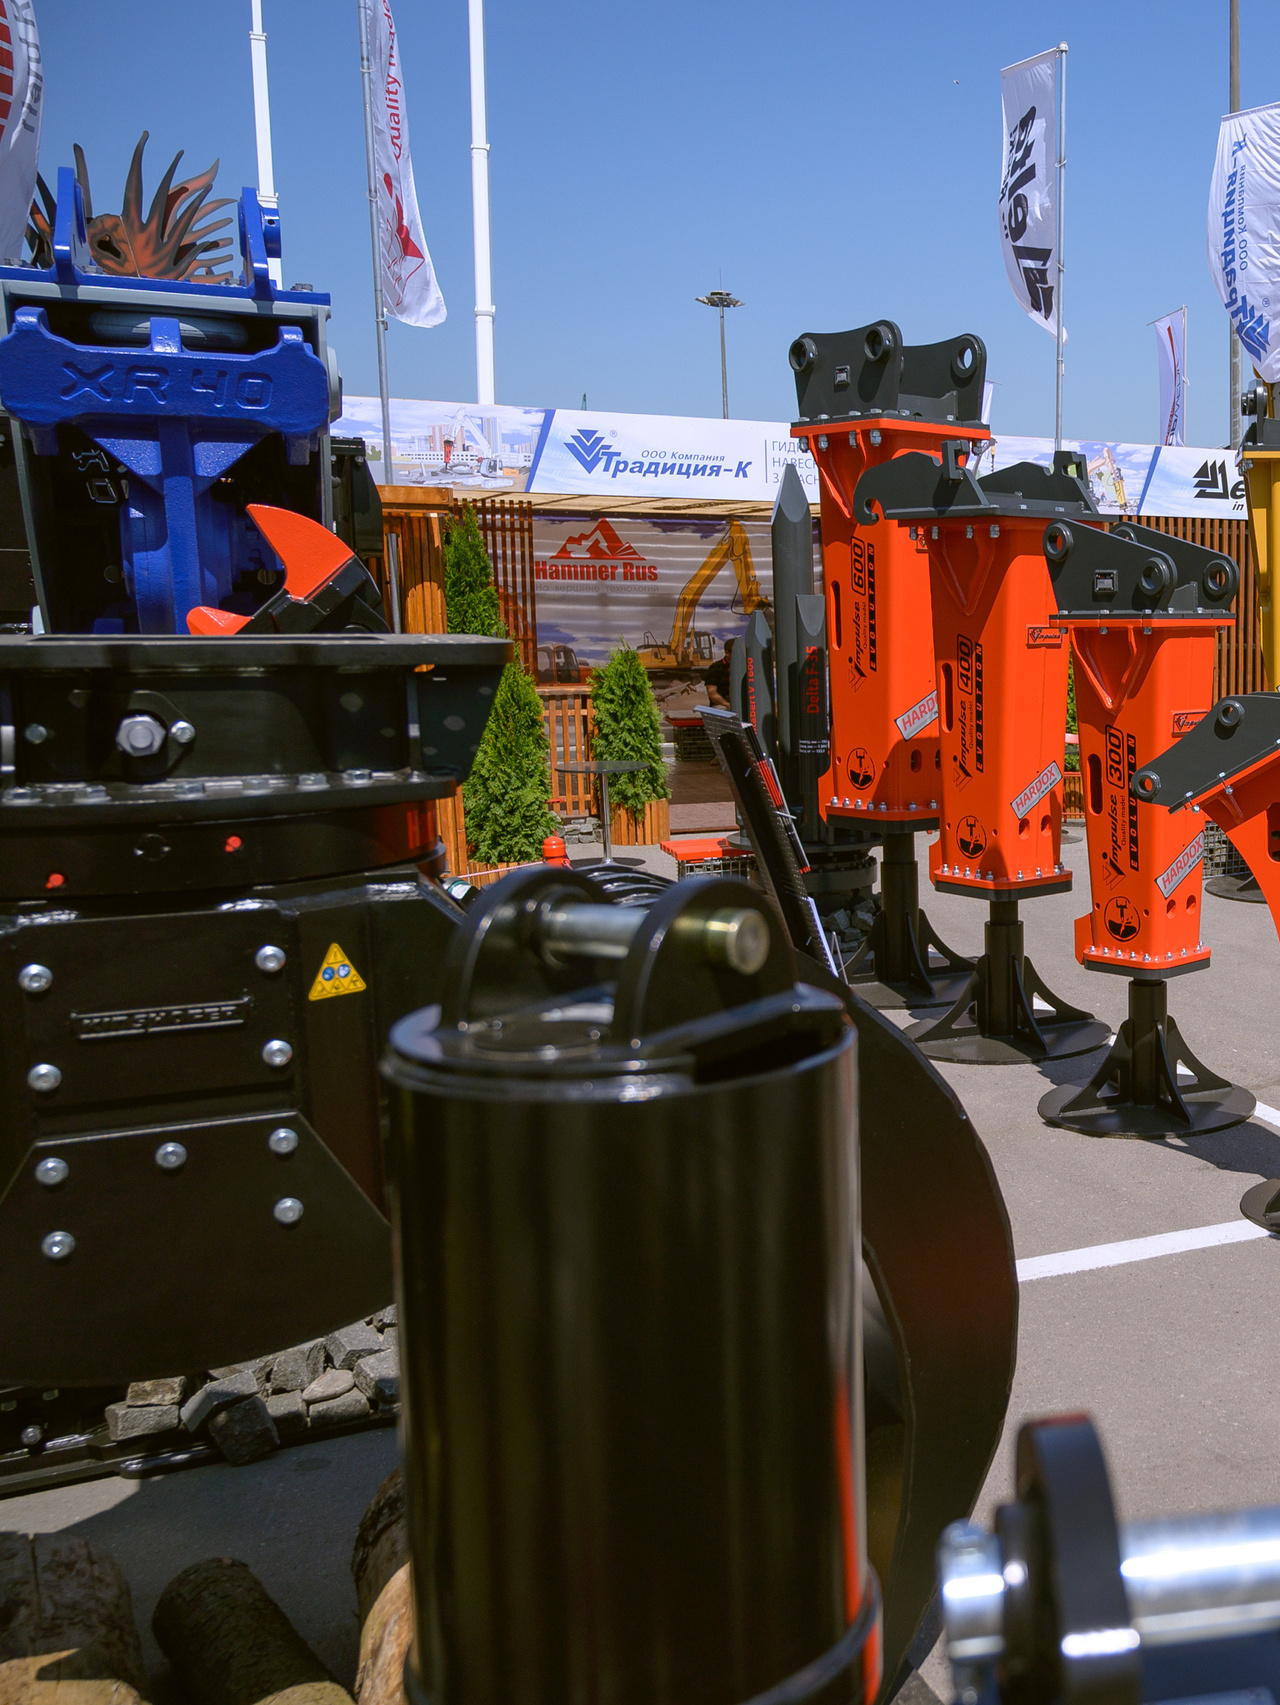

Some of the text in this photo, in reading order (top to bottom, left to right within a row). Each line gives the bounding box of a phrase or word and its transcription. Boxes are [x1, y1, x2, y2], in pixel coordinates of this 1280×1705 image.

[61, 361, 273, 410] XR 40
[601, 451, 752, 478] Традиция-К
[641, 450, 725, 463] ООО Компания
[535, 561, 658, 581] Hammer Rus
[853, 542, 863, 589] 600
[555, 585, 600, 594] вершине
[959, 641, 971, 688] 400
[806, 678, 820, 714] Delta
[902, 692, 937, 731] HARD
[1109, 733, 1122, 782] 300
[1015, 766, 1056, 811] HARDOX
[1162, 836, 1203, 890] HARDOX
